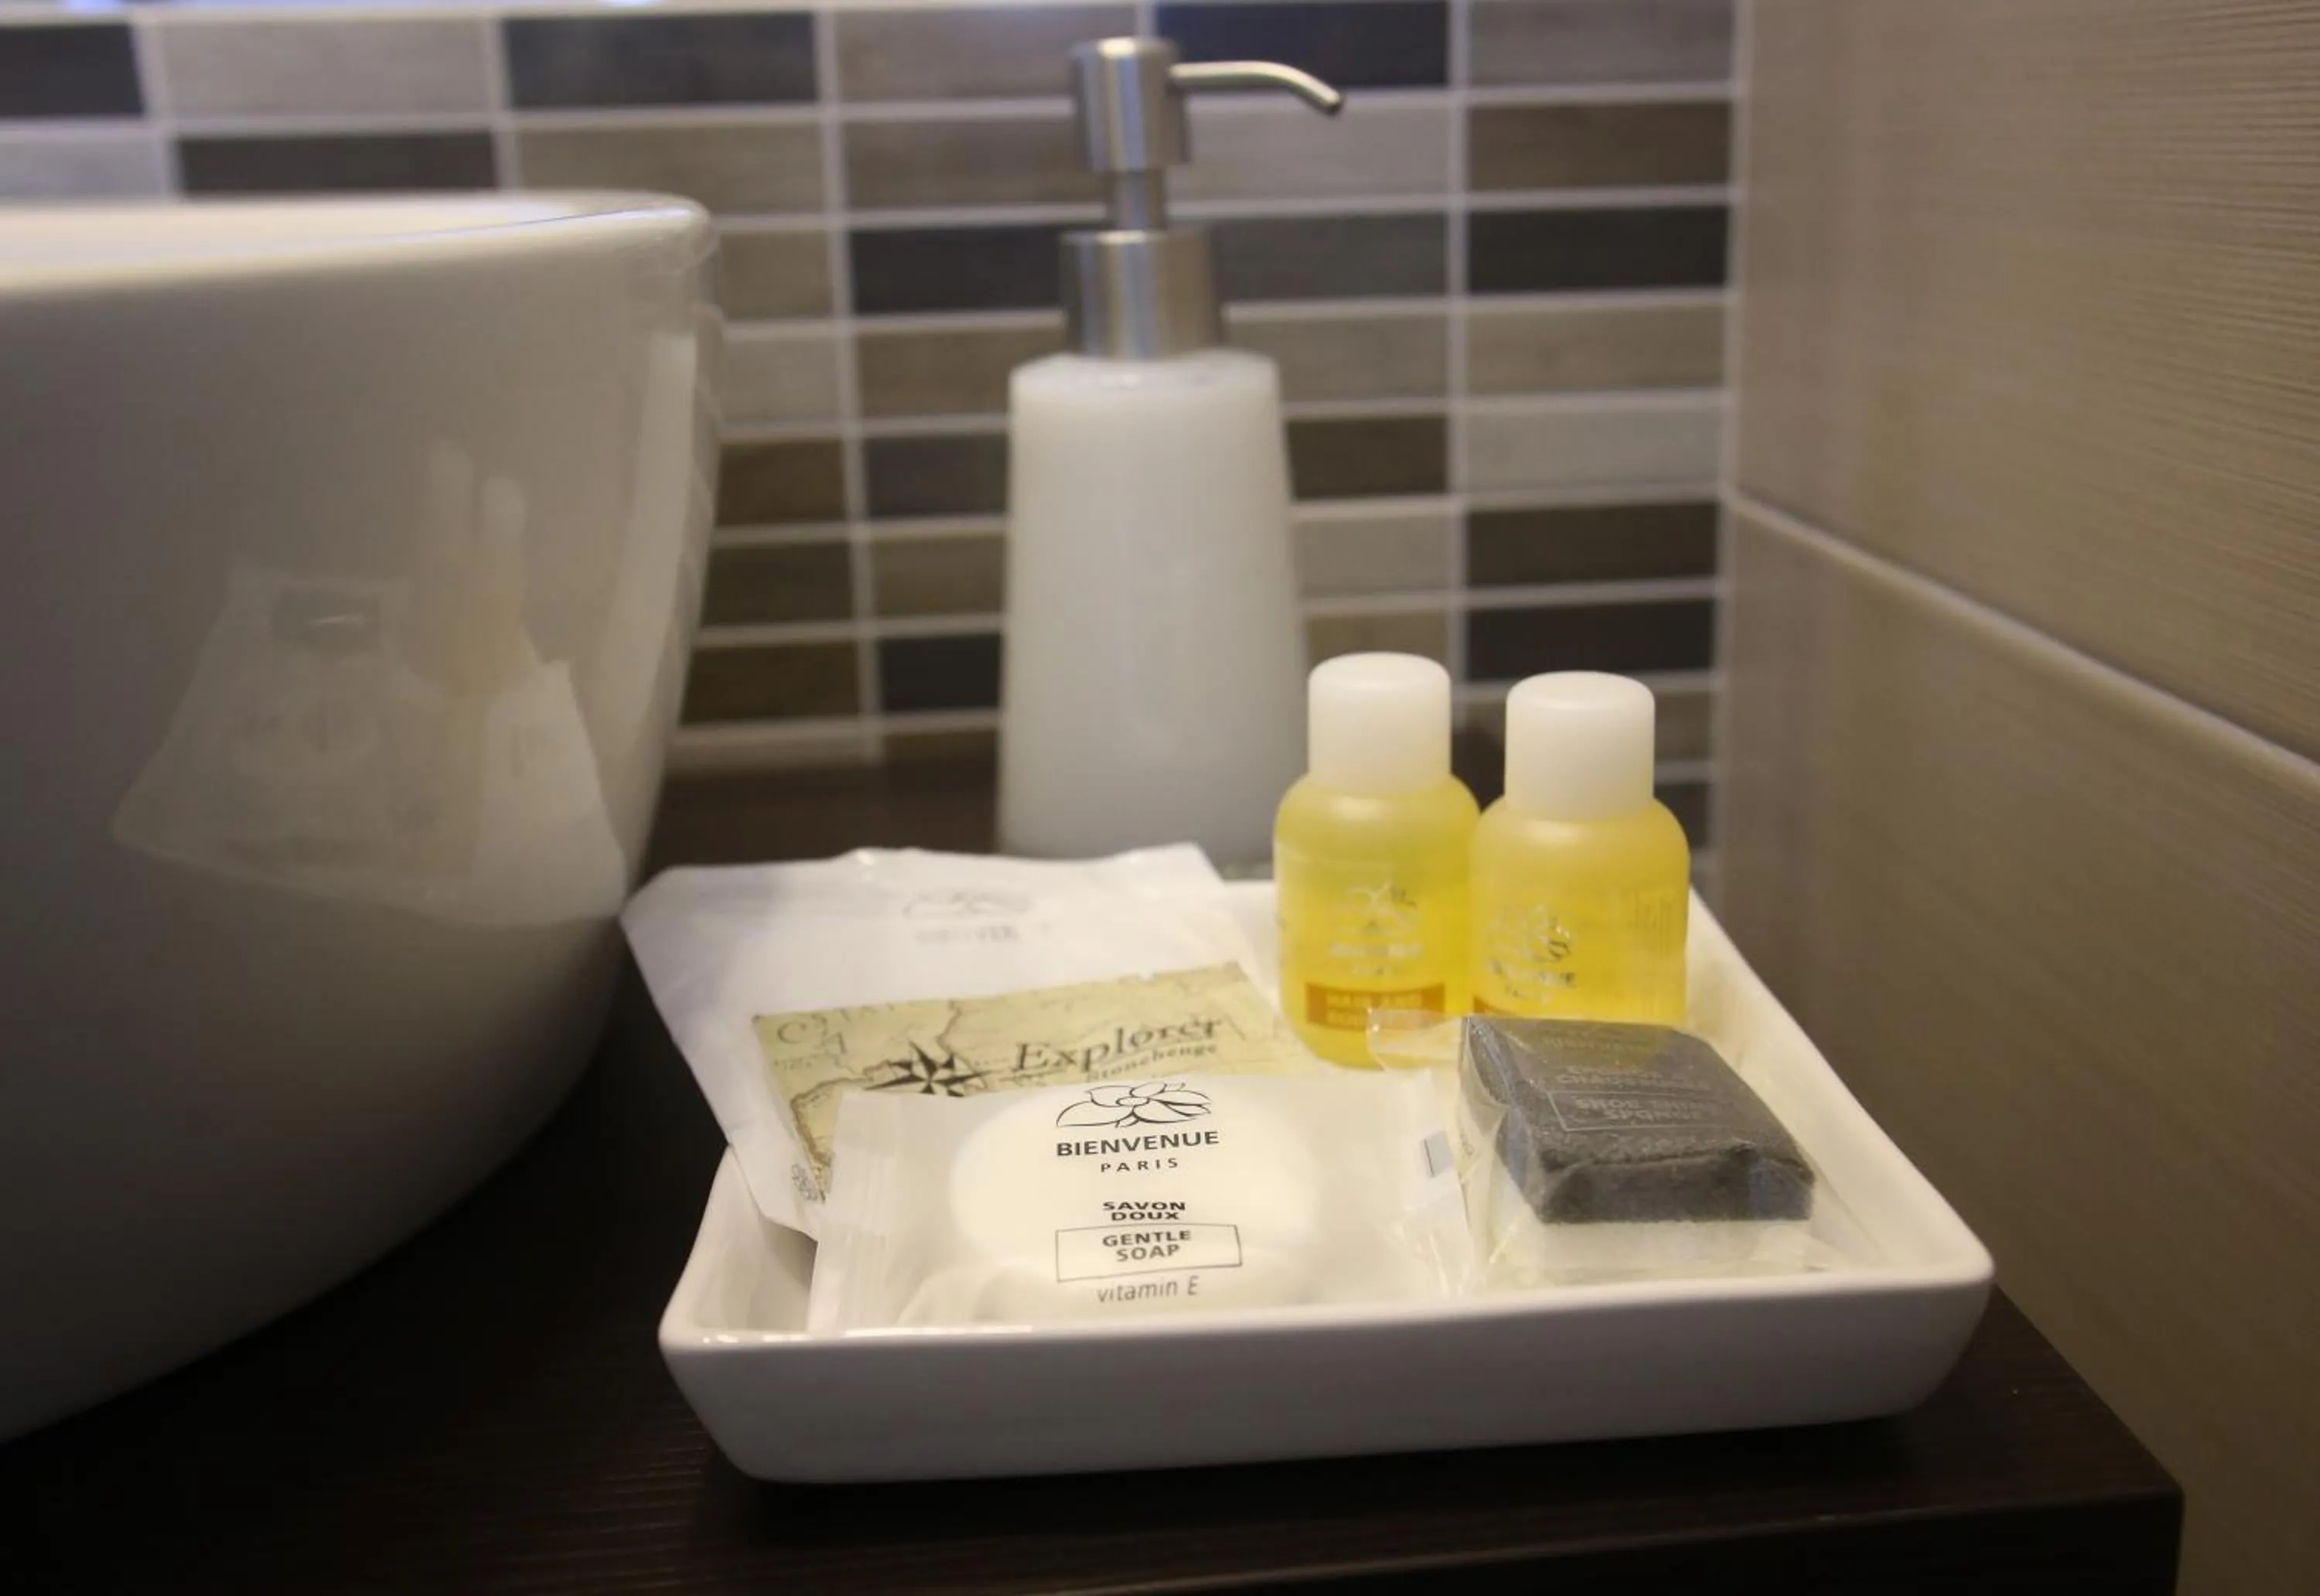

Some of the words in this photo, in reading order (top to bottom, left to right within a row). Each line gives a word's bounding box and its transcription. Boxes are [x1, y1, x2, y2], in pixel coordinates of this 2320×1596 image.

[1012, 1018, 1222, 1073] Explorer
[1056, 1131, 1220, 1157] BIENVENUE
[1100, 1158, 1179, 1173] PARIS
[1103, 1202, 1186, 1211] SAVON
[1111, 1212, 1179, 1221] DOUX
[1102, 1230, 1192, 1247] GENTLE
[1116, 1244, 1180, 1262] SOAP
[1097, 1281, 1179, 1302] vitamin
[1187, 1275, 1200, 1296] E
